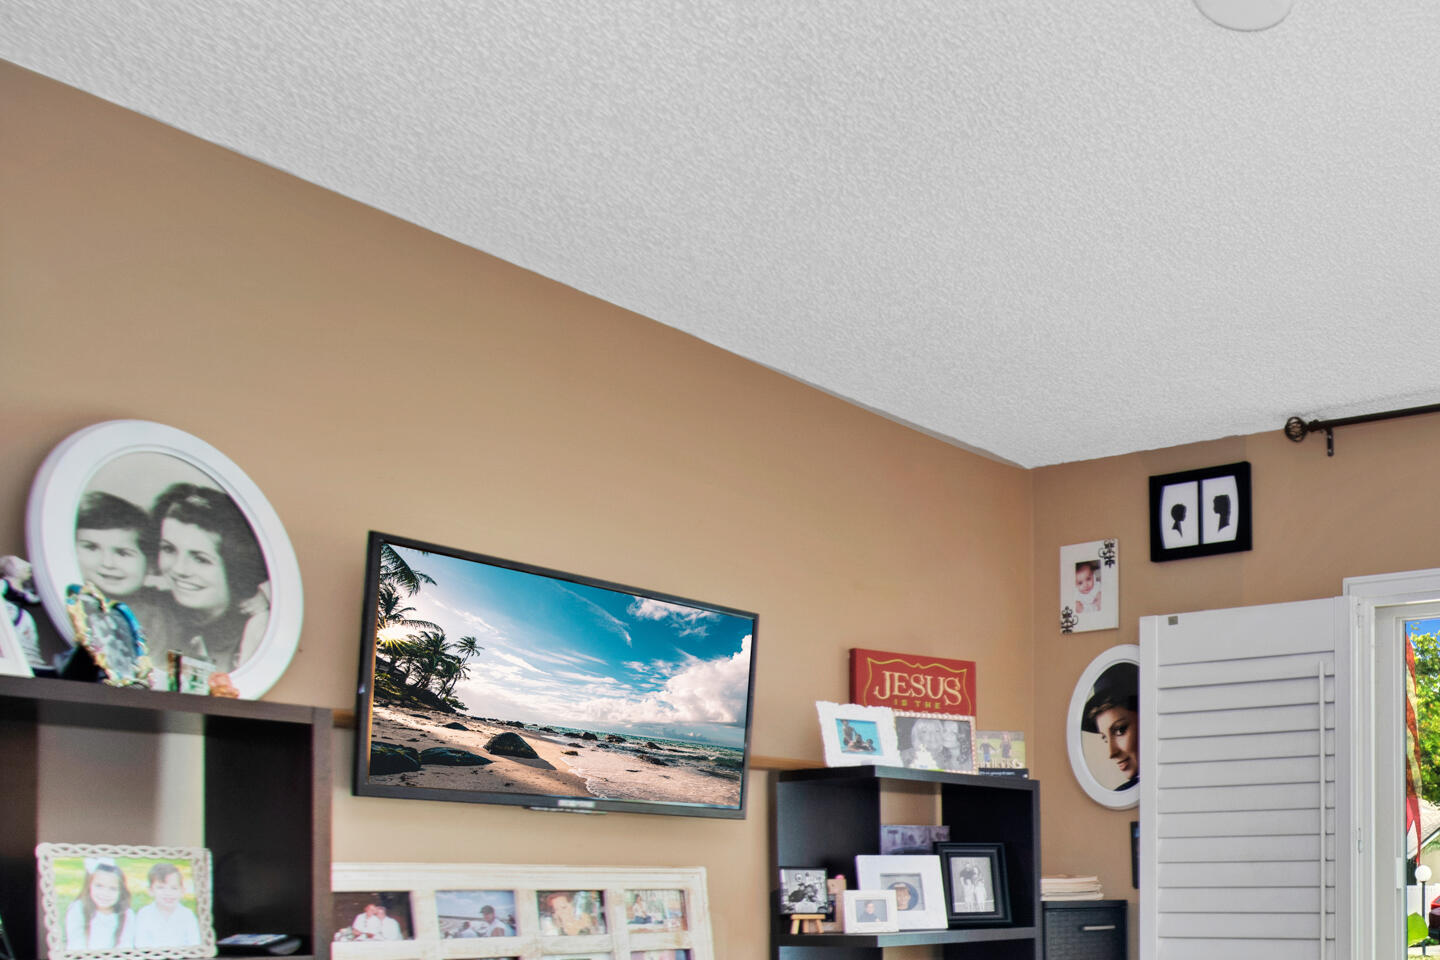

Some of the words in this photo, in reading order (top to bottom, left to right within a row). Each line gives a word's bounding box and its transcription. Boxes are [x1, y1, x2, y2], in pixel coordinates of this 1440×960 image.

[873, 670, 962, 705] JESUS
[894, 698, 908, 707] IS
[914, 700, 941, 710] THE
